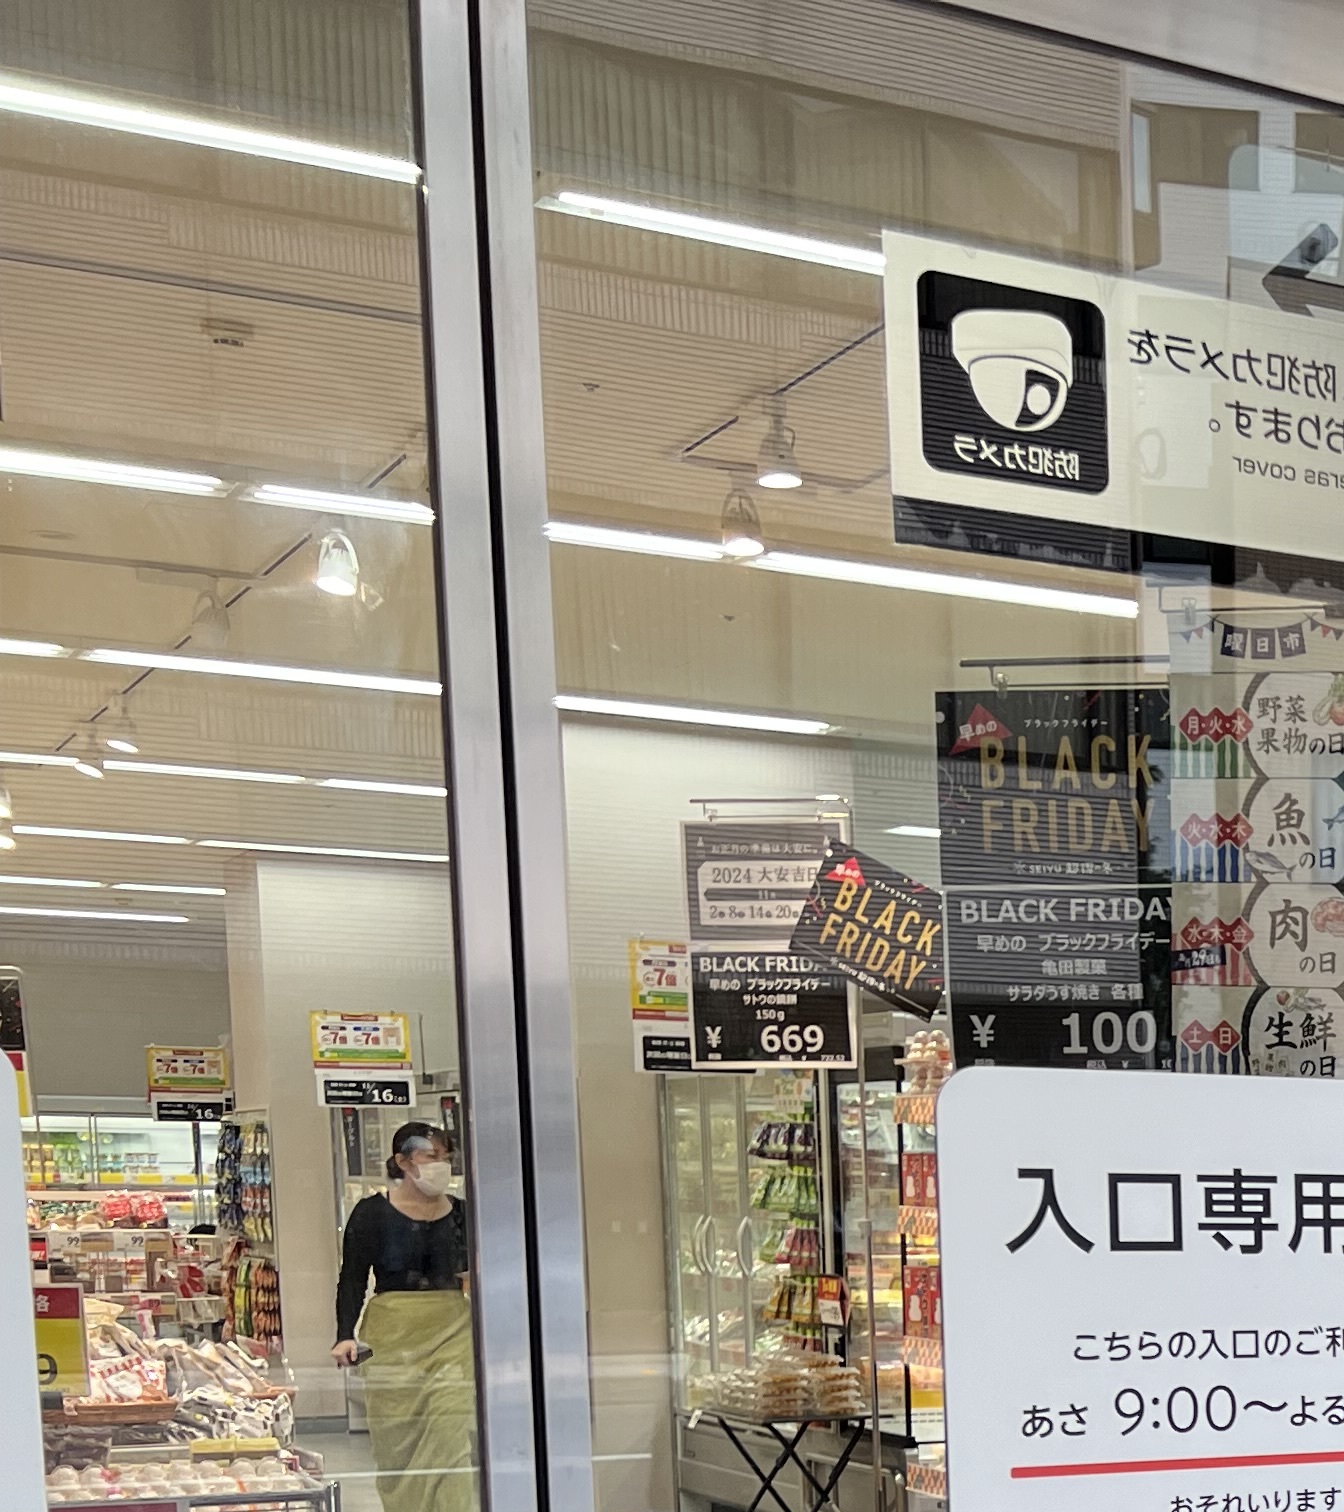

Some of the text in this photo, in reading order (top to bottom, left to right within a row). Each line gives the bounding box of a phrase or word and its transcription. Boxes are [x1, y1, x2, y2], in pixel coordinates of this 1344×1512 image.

[1223, 631, 1302, 653] 曜日市
[1255, 694, 1308, 725] 野菜
[959, 719, 998, 742] 早めの
[1023, 718, 1109, 729] ブラックフライデー
[979, 733, 1154, 791] BLACK
[980, 796, 1155, 854] FRIDAY
[1267, 792, 1311, 848] 魚
[1299, 846, 1336, 870] の日
[712, 865, 818, 884] 2024 大安吉日
[832, 877, 942, 957] BLACK
[960, 898, 1059, 924] BLACK
[1267, 898, 1310, 952] 肉
[818, 912, 927, 991] FRIDAY
[976, 932, 1171, 952] 早めの ブラックフライデー
[699, 956, 760, 973] BLACK
[1299, 951, 1337, 975] の日
[1006, 983, 1145, 1002] サラダうす焼き 各種
[704, 1024, 825, 1053] ¥ 669
[968, 1011, 1157, 1056] ¥ 100
[1264, 1011, 1337, 1053] 生鮮
[1299, 1054, 1337, 1078] の日
[1020, 1401, 1089, 1439] あさ
